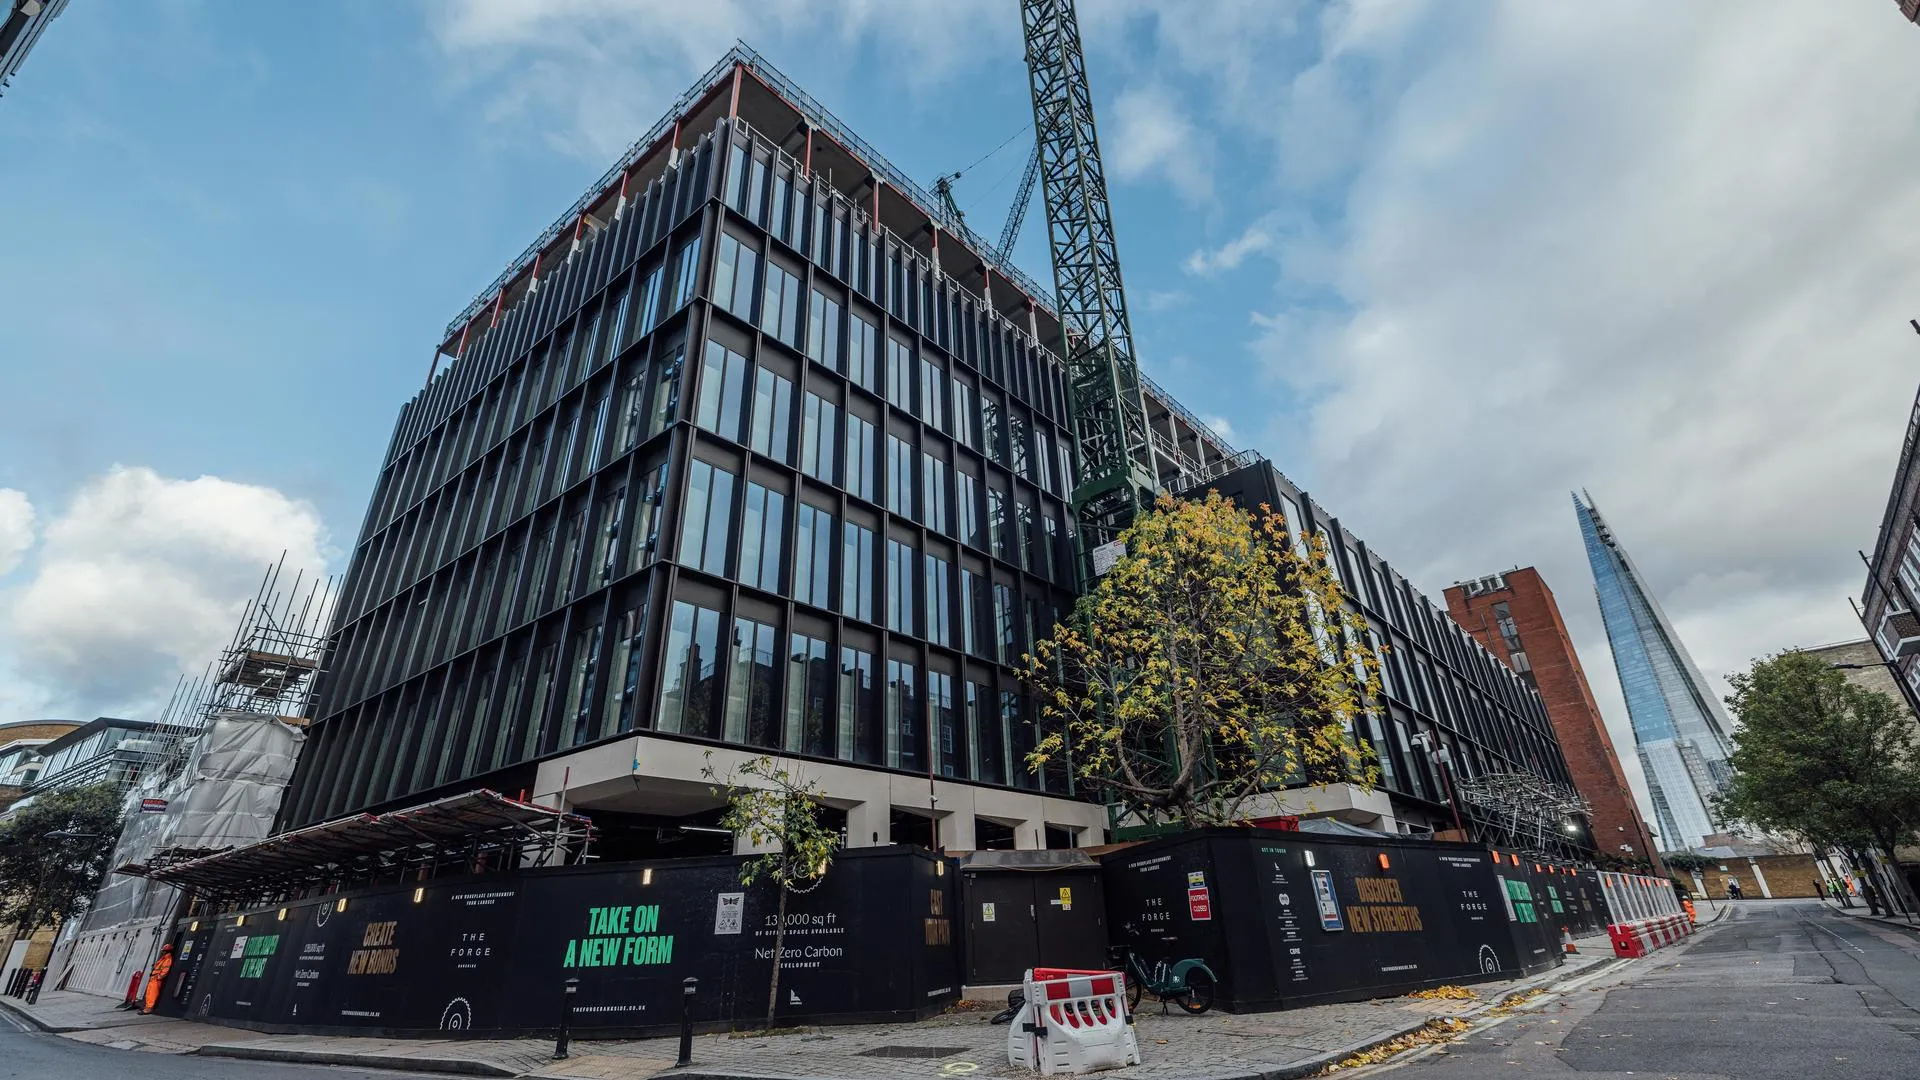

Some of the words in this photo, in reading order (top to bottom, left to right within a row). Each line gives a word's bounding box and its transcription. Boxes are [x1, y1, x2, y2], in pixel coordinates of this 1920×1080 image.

[1355, 877, 1403, 903] DISCOVER
[1146, 898, 1162, 906] THE
[589, 906, 632, 935] TAKE
[634, 905, 659, 933] ON
[765, 914, 810, 927] 13,000
[812, 916, 824, 926] sq
[827, 913, 836, 924] ft
[1142, 912, 1170, 921] FORGE
[1346, 906, 1372, 932] NEW
[1370, 906, 1423, 932] STRENGTHS
[362, 921, 398, 946] CREATE
[462, 933, 485, 942] THE
[450, 948, 491, 956] FORGE
[563, 940, 576, 968] A
[579, 938, 622, 967] NEW
[622, 935, 674, 966] FORM
[755, 948, 775, 959] Net
[780, 946, 802, 958] Zero
[805, 946, 843, 958] Carbon
[348, 950, 370, 975] NEW
[366, 949, 399, 974] BONDS
